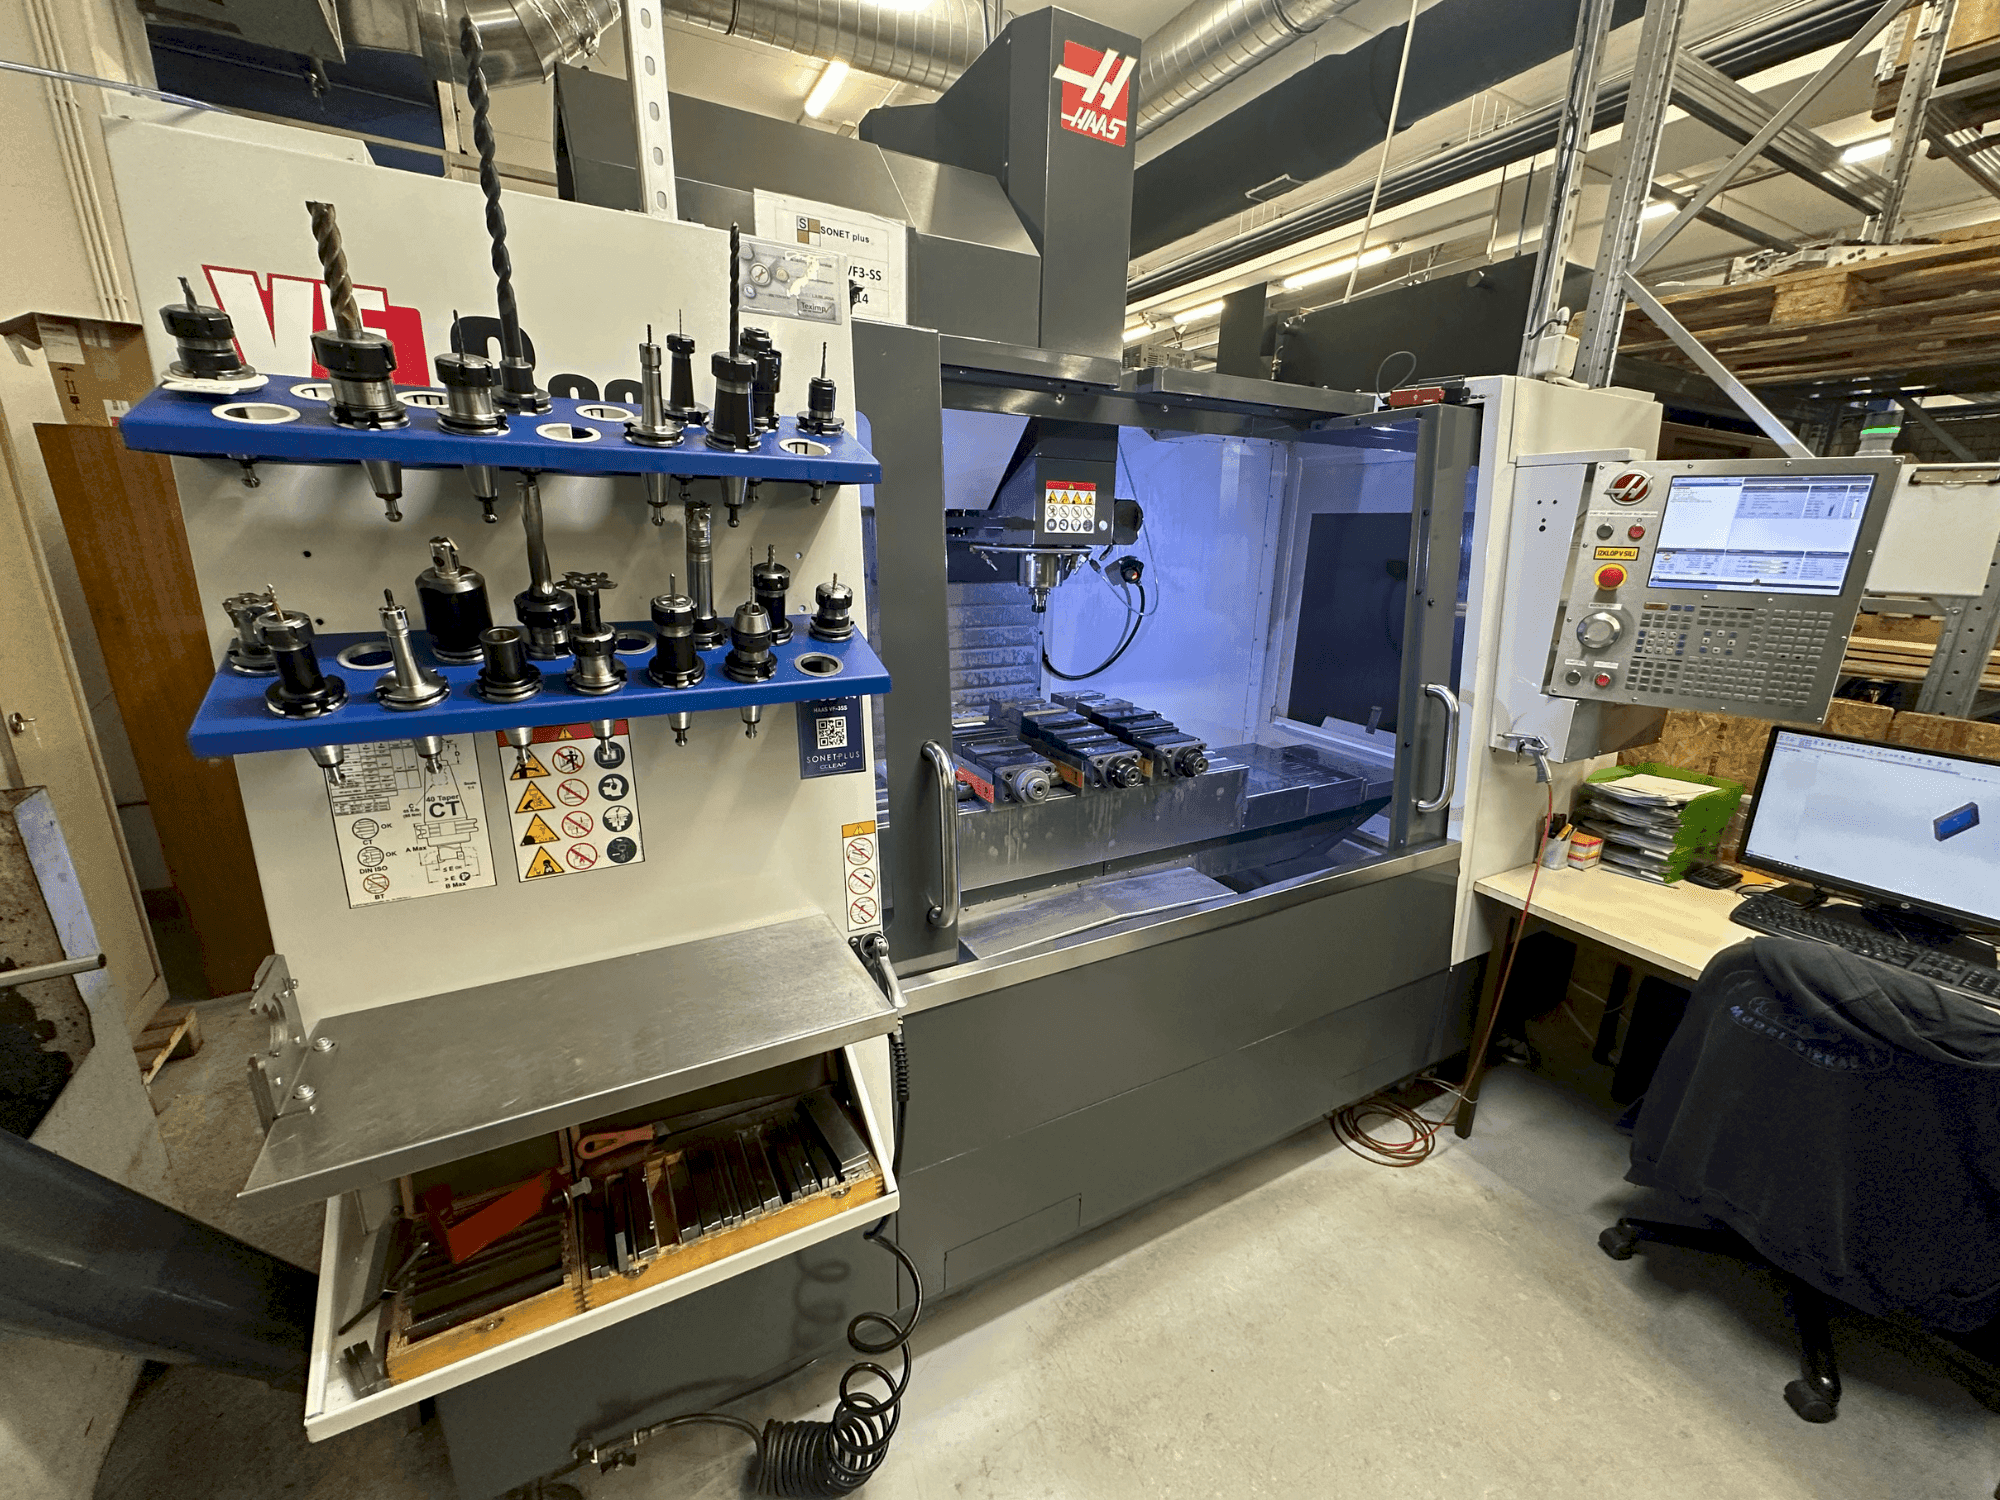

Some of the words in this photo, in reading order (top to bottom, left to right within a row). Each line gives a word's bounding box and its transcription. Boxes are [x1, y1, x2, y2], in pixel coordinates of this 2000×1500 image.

[1061, 107, 1127, 140] HAAS
[820, 226, 850, 239] SONET
[852, 233, 870, 243] plus
[813, 705, 828, 713] HAAS
[437, 794, 459, 802] Taper
[429, 800, 460, 818] CT
[359, 867, 373, 875] DIN
[374, 865, 388, 873] ISO
